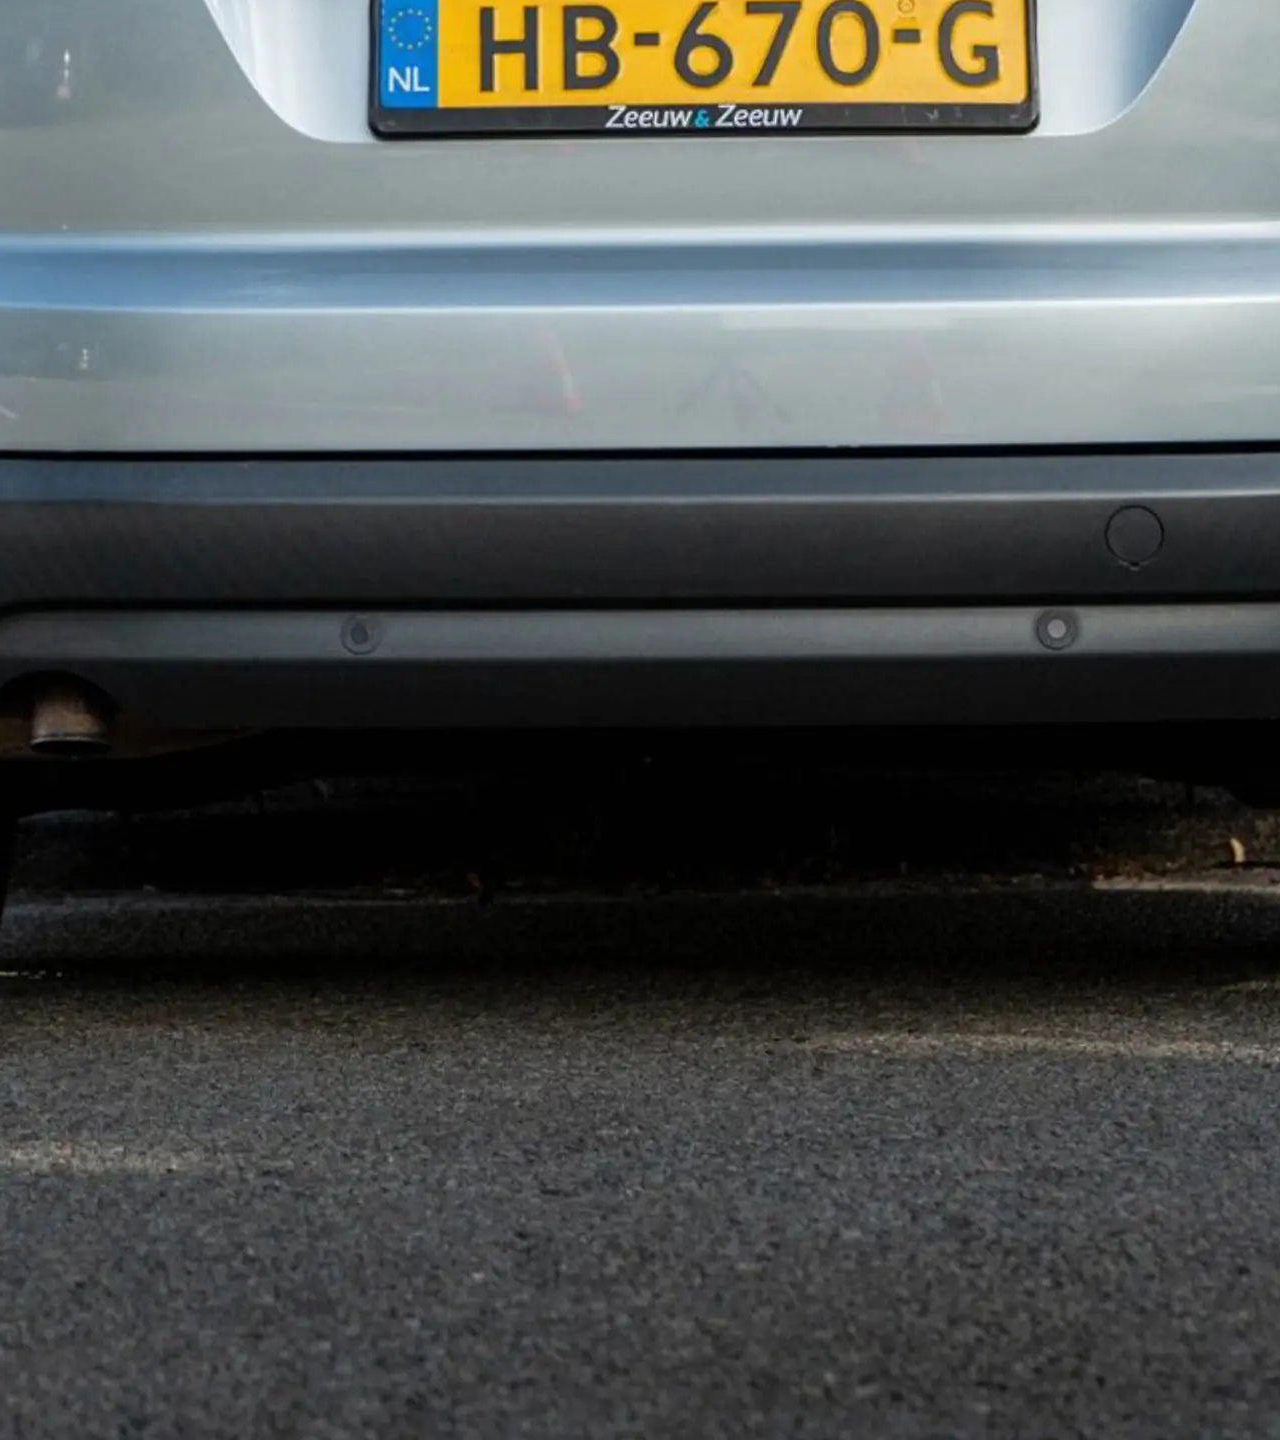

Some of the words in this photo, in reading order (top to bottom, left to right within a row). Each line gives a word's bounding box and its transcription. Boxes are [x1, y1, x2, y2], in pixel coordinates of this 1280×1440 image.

[387, 66, 431, 93] NL
[605, 105, 693, 128] Zeeuw
[714, 103, 803, 127] Zeeuw
